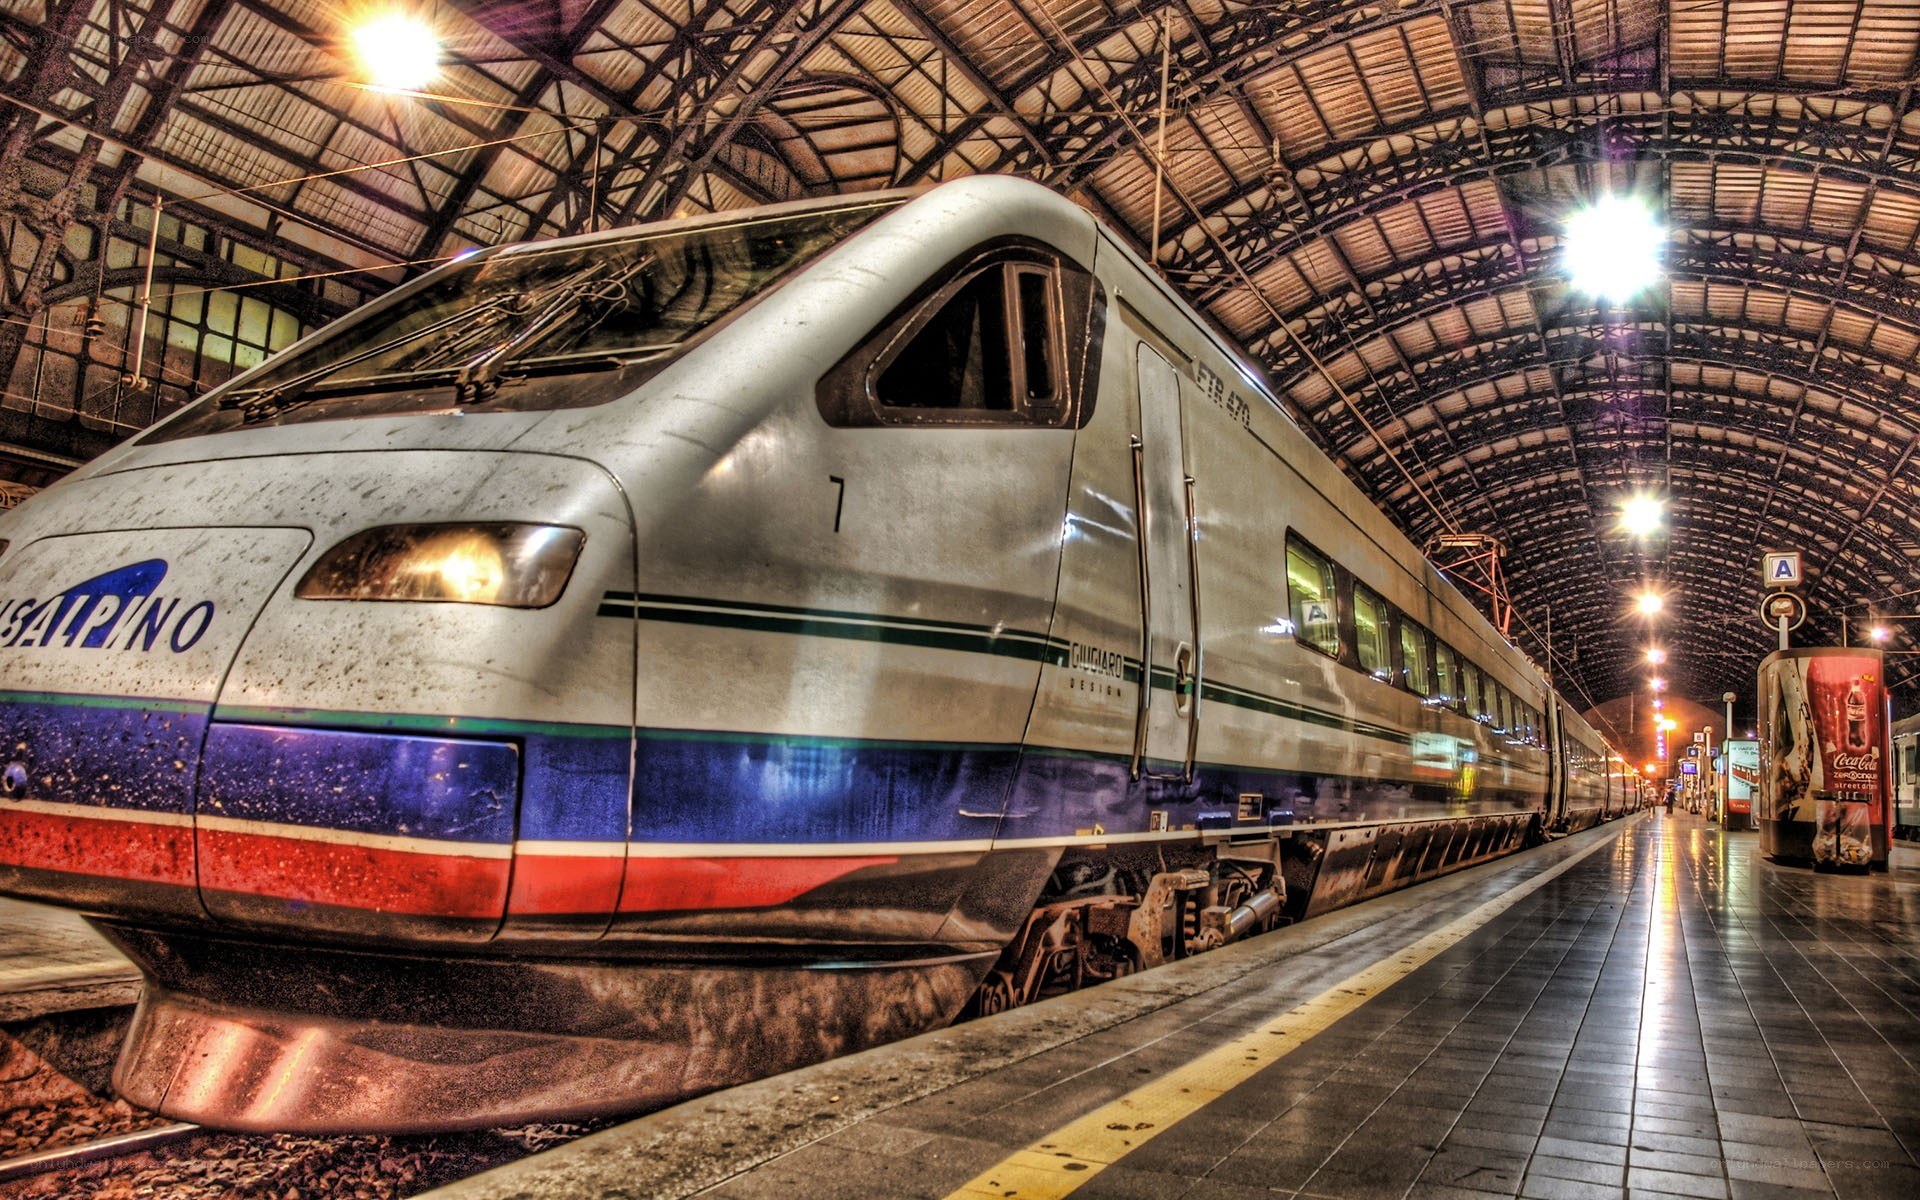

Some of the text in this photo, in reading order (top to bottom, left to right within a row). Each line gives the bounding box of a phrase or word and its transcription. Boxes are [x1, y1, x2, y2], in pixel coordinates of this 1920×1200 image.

[1197, 360, 1224, 409] ETR
[1775, 559, 1793, 578] A
[1071, 642, 1122, 678] GIUGIARO
[1070, 678, 1121, 697] DESIGN
